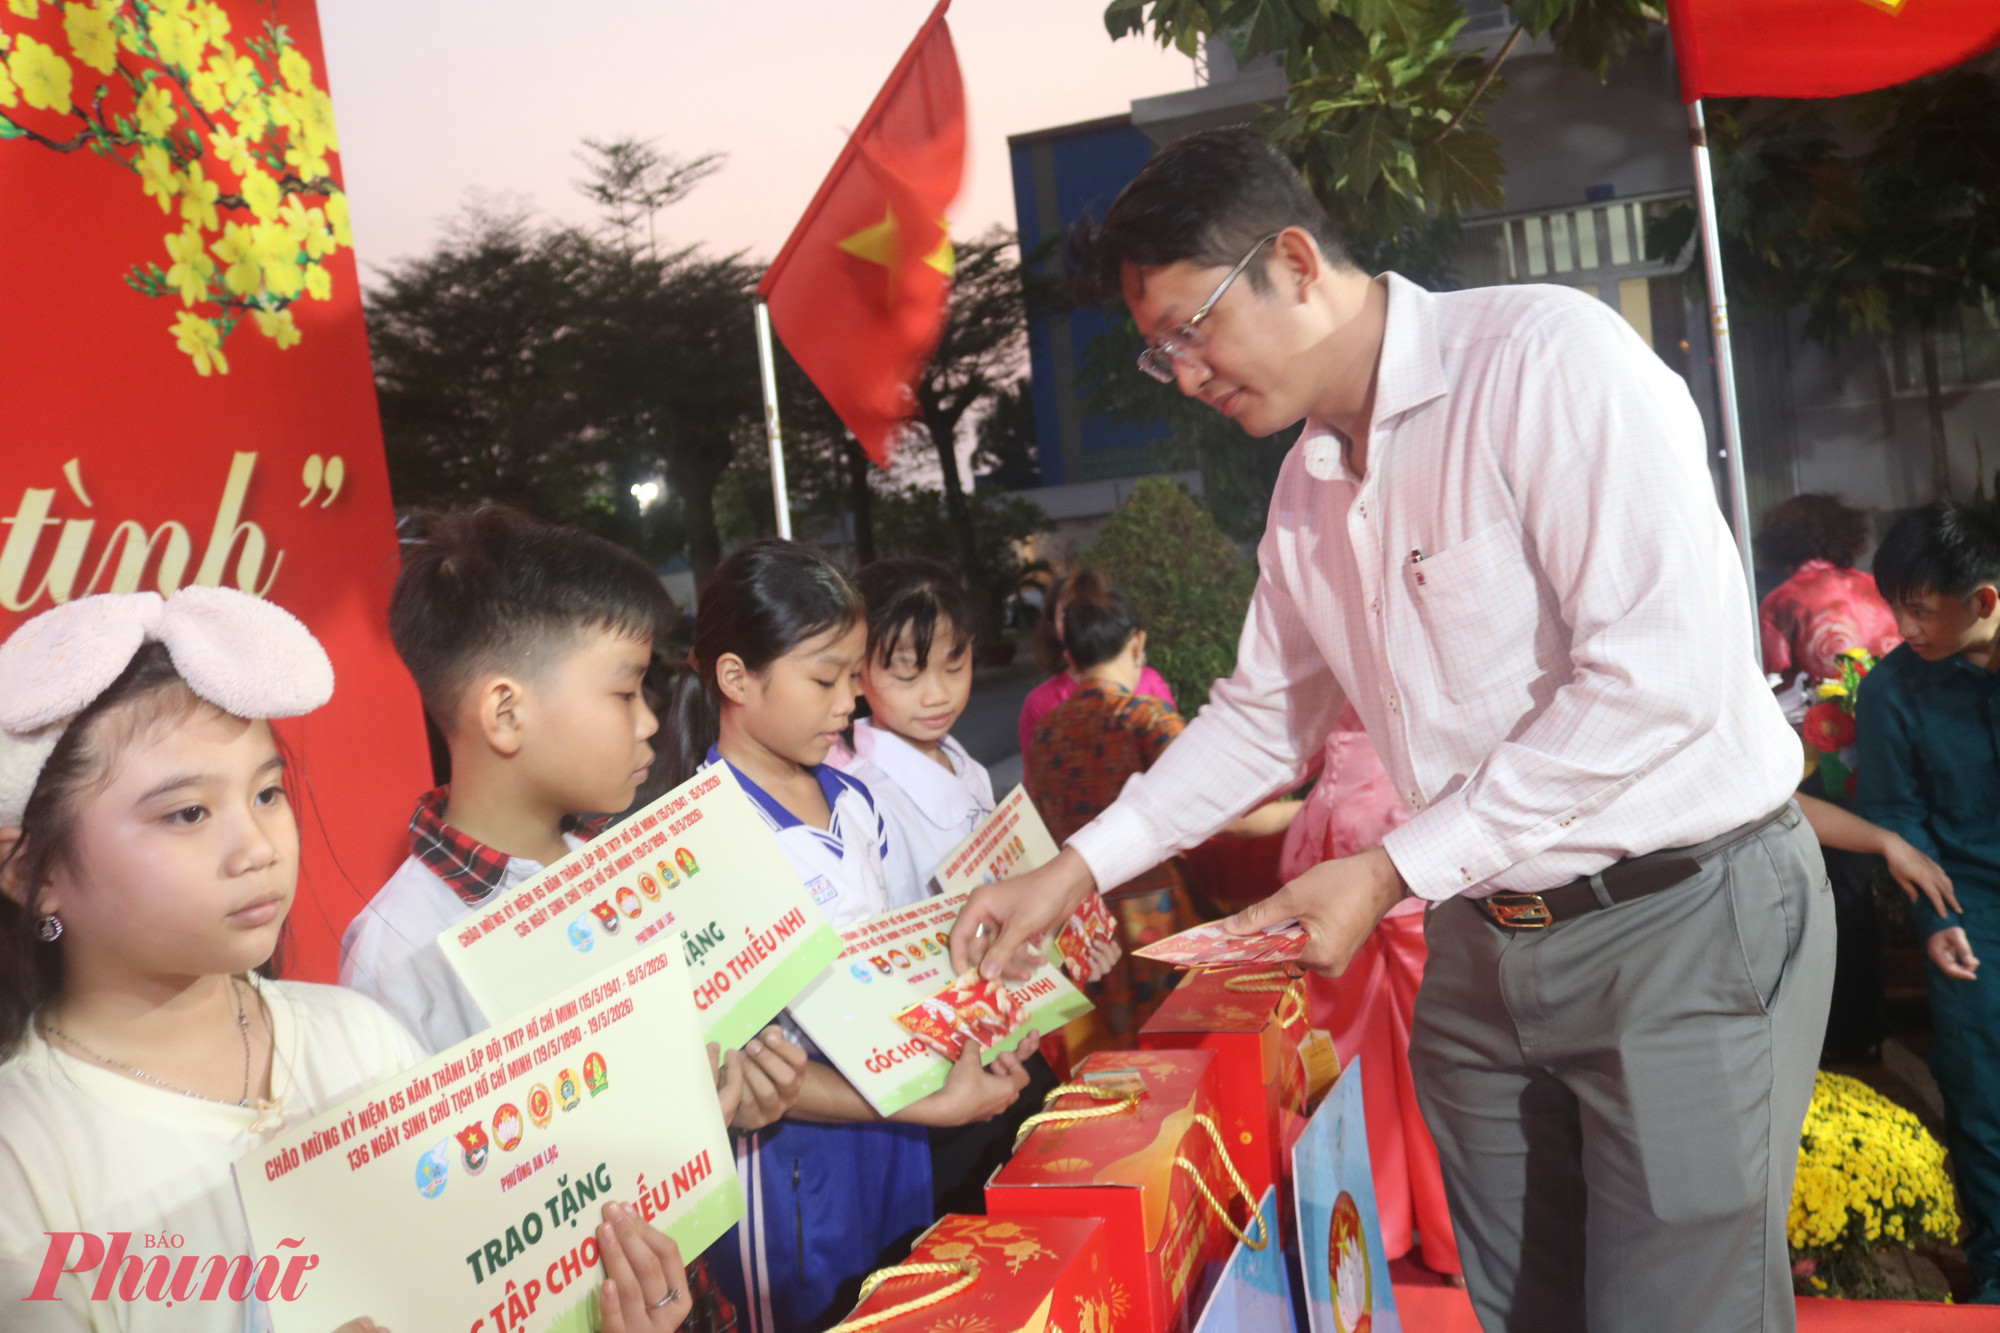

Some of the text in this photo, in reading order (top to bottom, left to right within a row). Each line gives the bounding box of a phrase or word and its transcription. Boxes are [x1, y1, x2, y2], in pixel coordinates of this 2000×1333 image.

[683, 920, 725, 967] ẶNG
[693, 971, 731, 1011] CHO
[726, 926, 777, 980] THIẾU
[773, 906, 806, 942] NHI
[1027, 977, 1057, 998] NHI
[265, 1148, 300, 1181] CHÀO
[301, 1126, 340, 1162] MỪNG
[341, 1111, 356, 1141] KỶ
[358, 1101, 388, 1131] NIỆM
[389, 1091, 405, 1114] 85
[406, 1078, 432, 1105] NĂM
[432, 1059, 466, 1090] THÀNH
[466, 1048, 484, 1073] LẬP
[485, 1037, 503, 1062] ĐỘI
[502, 1028, 524, 1053] TNTP
[540, 1008, 555, 1033] CHÍ
[555, 1000, 578, 1025] MINH
[578, 977, 621, 1012] (15/5/1941
[626, 952, 668, 986] 15/5/2026)
[347, 1144, 370, 1171] 136
[370, 1126, 401, 1158] NGÀY
[401, 1111, 428, 1140] SINH
[429, 1093, 450, 1125] CHỦ
[450, 1085, 474, 1114] TỊCH
[490, 1062, 507, 1090] CHÍ
[507, 1053, 533, 1081] MINH
[533, 1025, 582, 1066] (19/5/1890
[587, 997, 634, 1035] 19/5/2026)
[865, 1038, 929, 1074] GÓC HỌ
[500, 1144, 559, 1193] PHƯỜNG AN LẠC
[466, 1162, 612, 1285] TRAO TẶNG
[489, 1279, 541, 1333] TẬP
[546, 1236, 601, 1294] CHO
[672, 1149, 712, 1199] NHI
